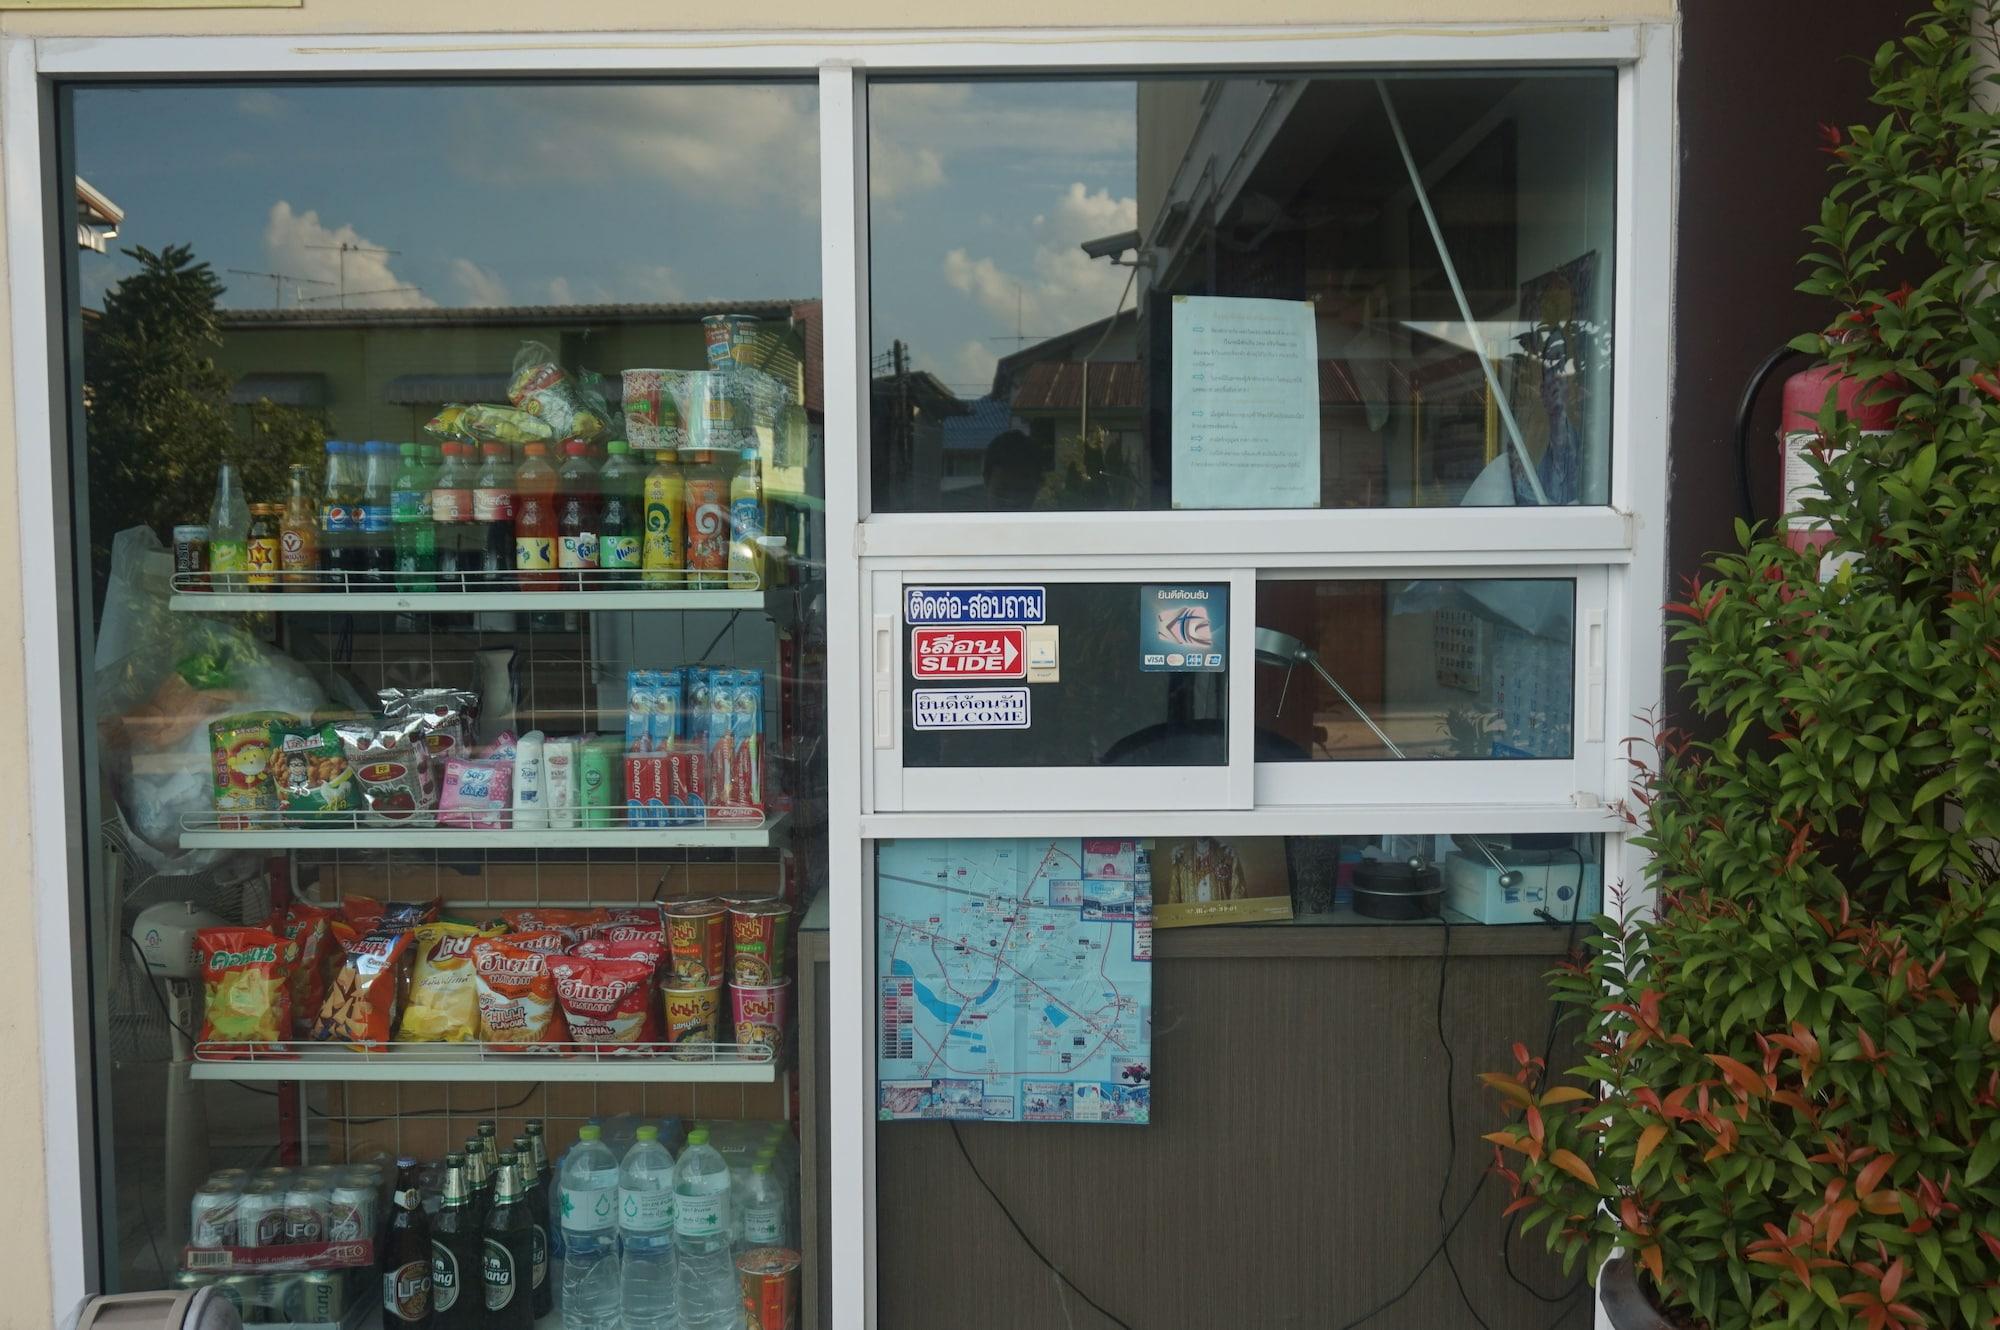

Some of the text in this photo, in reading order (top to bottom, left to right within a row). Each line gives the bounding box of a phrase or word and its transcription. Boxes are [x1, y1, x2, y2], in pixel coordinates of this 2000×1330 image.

[1158, 589, 1209, 600] ยินดีต้อนรับ
[910, 589, 1041, 620] ติดต่อ-สอบถาม
[920, 634, 1002, 655] เลื่อน
[920, 655, 1004, 672] SLIDE
[1146, 655, 1164, 664] VISA
[919, 694, 1024, 711] ยินดีต้อนรับ
[921, 711, 1024, 724] WELCOME
[479, 952, 545, 975] ฮานามิ
[559, 979, 627, 1002] ฮานามิ
[569, 1025, 614, 1035] ORIGINAL
